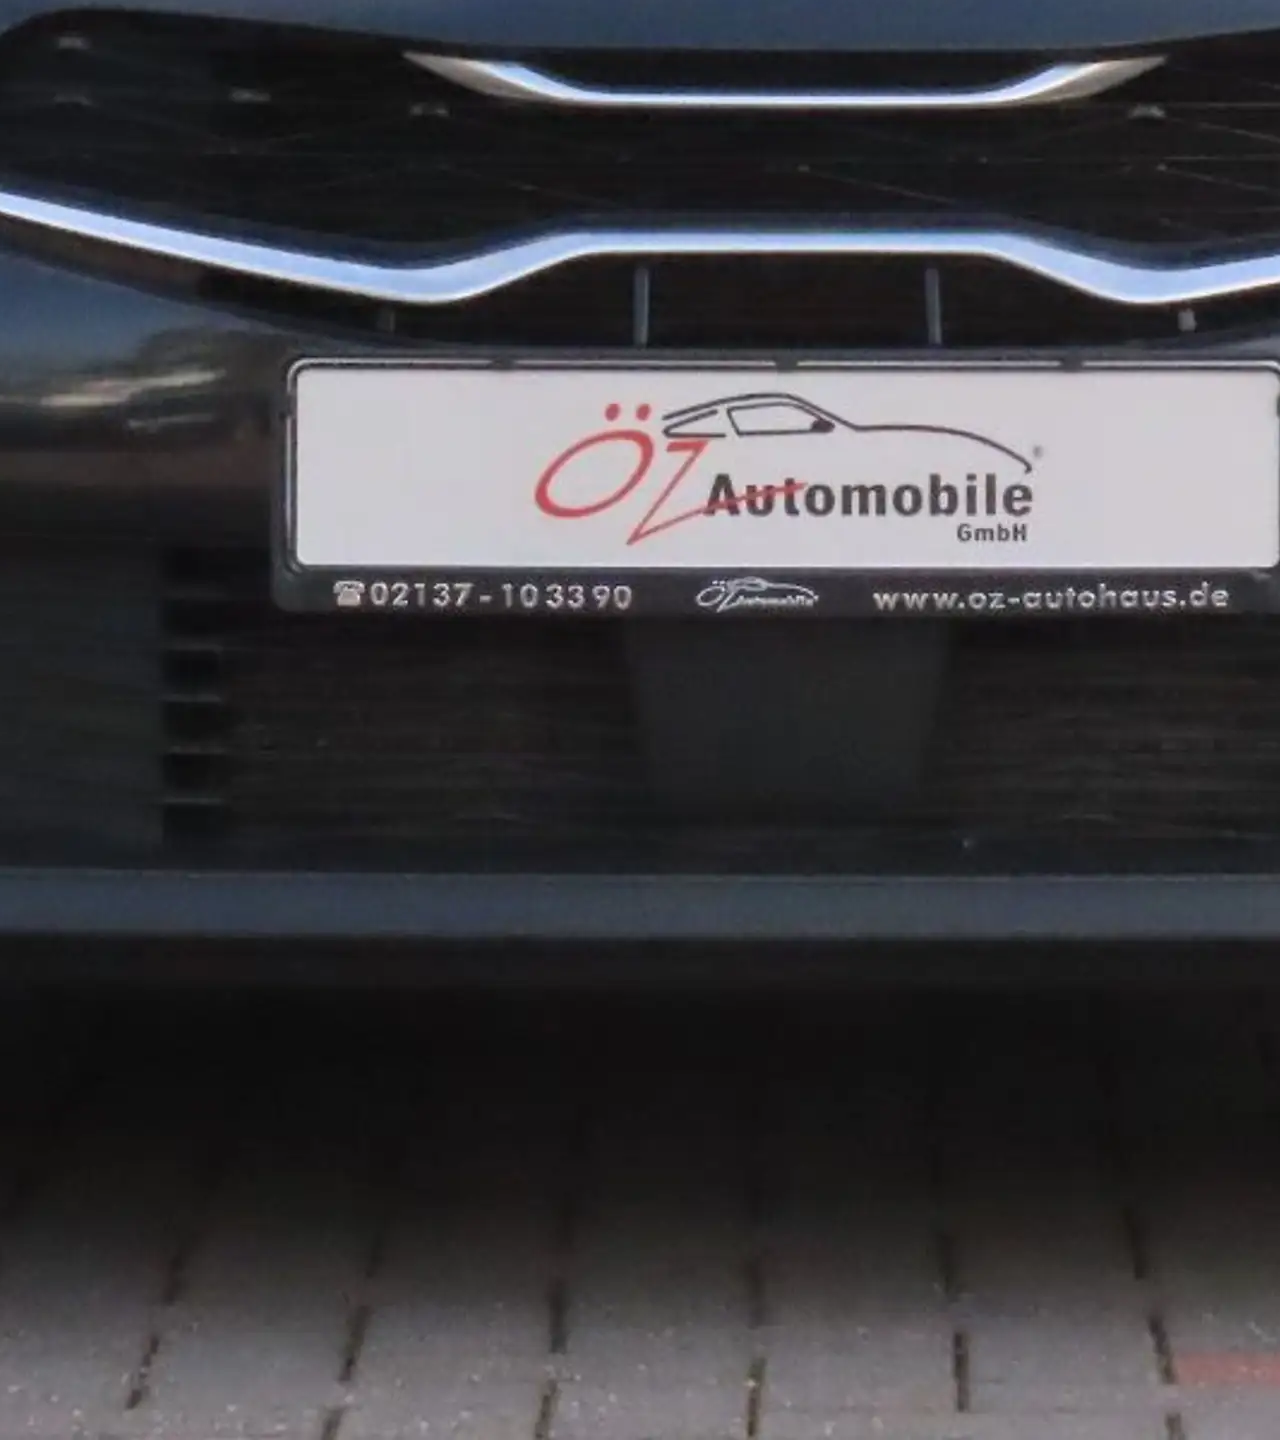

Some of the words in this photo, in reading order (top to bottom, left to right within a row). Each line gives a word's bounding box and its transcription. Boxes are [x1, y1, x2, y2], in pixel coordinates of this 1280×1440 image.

[702, 472, 1032, 517] Automobile
[956, 522, 1028, 543] GmbH
[872, 581, 1230, 611] www.oz-autohaus.de
